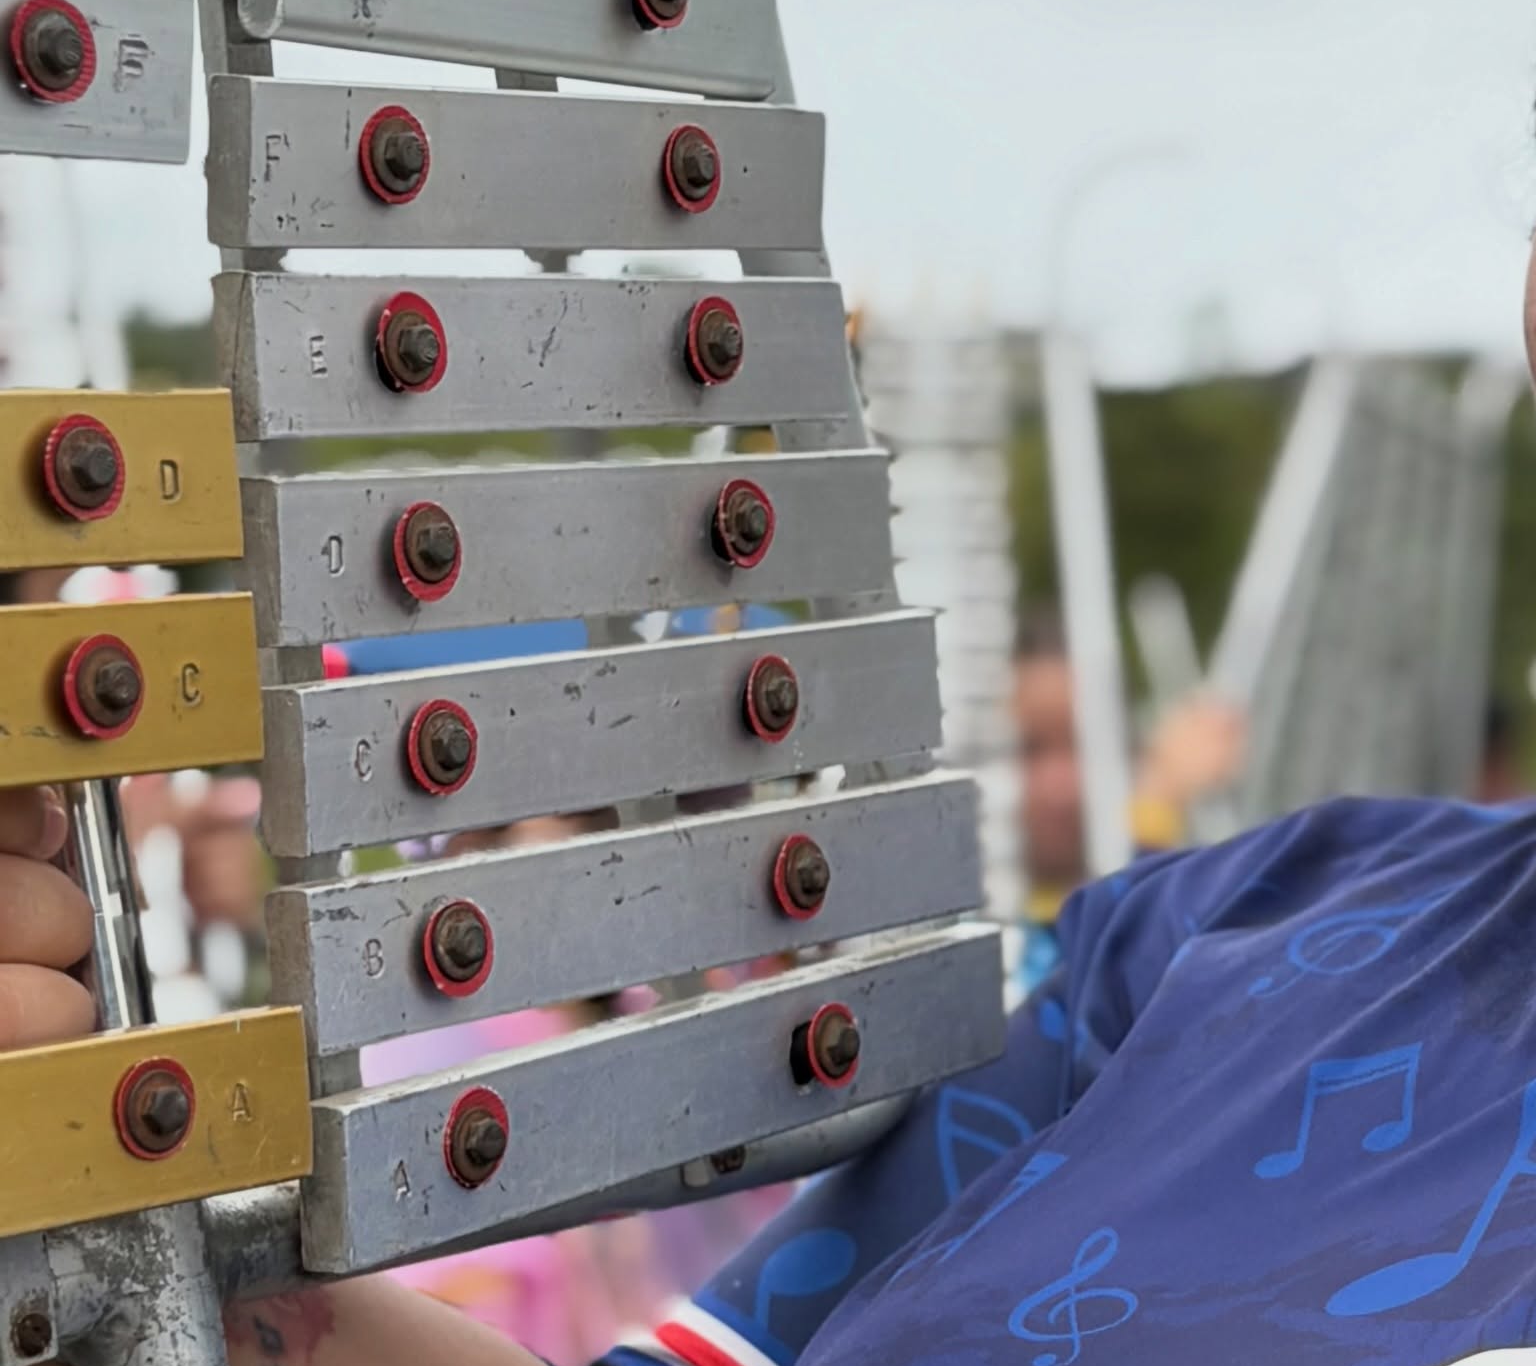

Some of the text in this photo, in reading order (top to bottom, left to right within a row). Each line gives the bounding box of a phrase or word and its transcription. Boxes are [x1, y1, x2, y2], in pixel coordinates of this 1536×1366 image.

[264, 134, 284, 183] F
[309, 334, 328, 376] E
[159, 457, 179, 502] D
[325, 535, 345, 577] D
[181, 663, 201, 707] C
[353, 738, 373, 782] C
[364, 937, 385, 979] B
[230, 1082, 251, 1122] A
[393, 1159, 413, 1202] A
